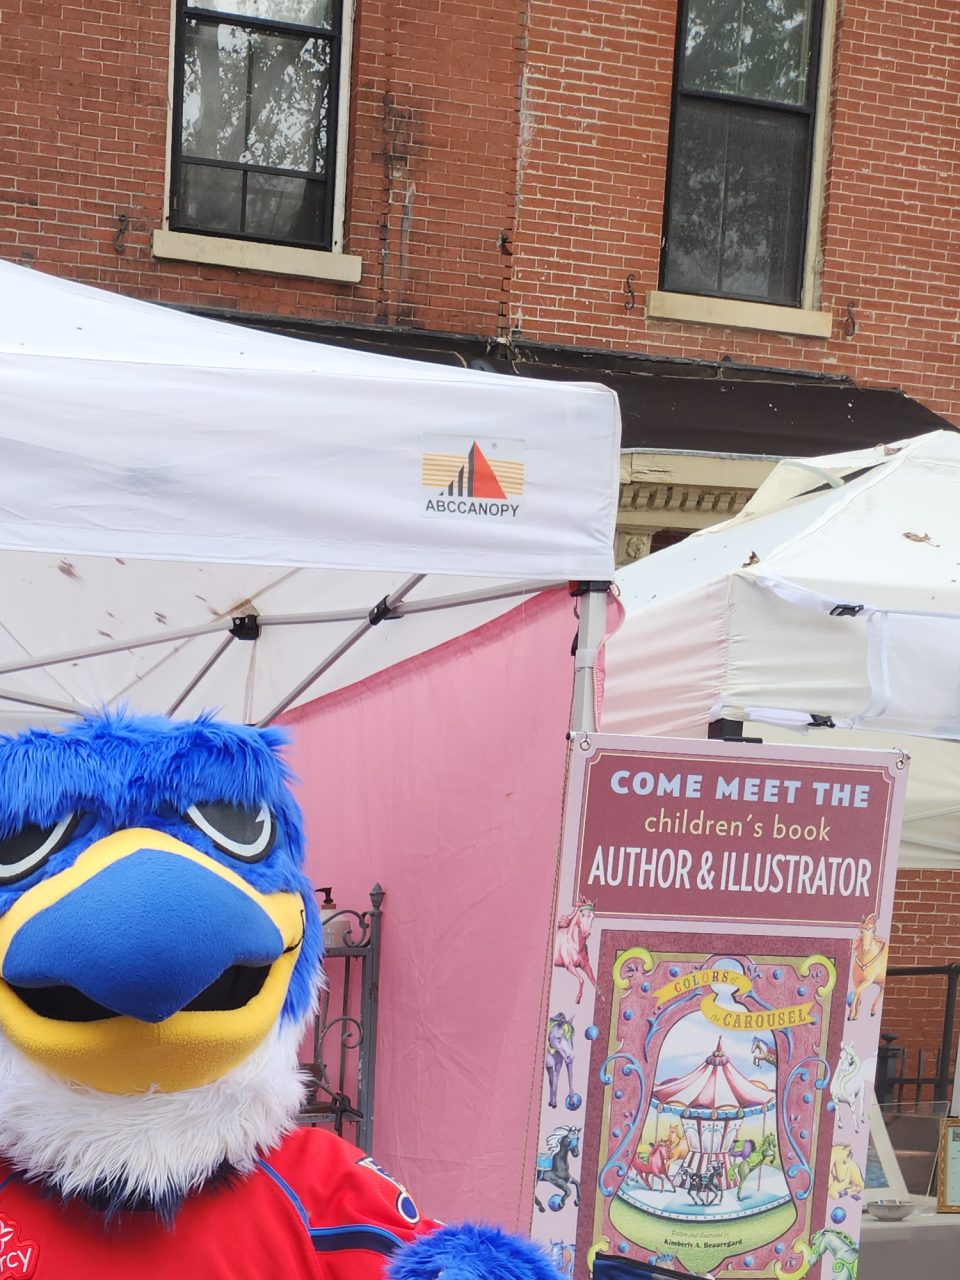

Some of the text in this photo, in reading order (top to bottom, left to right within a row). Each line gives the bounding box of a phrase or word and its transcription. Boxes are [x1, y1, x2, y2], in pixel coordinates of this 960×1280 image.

[425, 499, 520, 518] ABCCANOPY
[610, 769, 871, 808] COME MEET THE
[643, 807, 832, 842] children's book
[586, 844, 873, 897] AUTHOR & ILLUSTRATOR
[673, 970, 729, 993] COLORS
[723, 1008, 806, 1029] CAROUSEL
[663, 1238, 693, 1249] Kimberly
[703, 1239, 743, 1249] Beauregard
